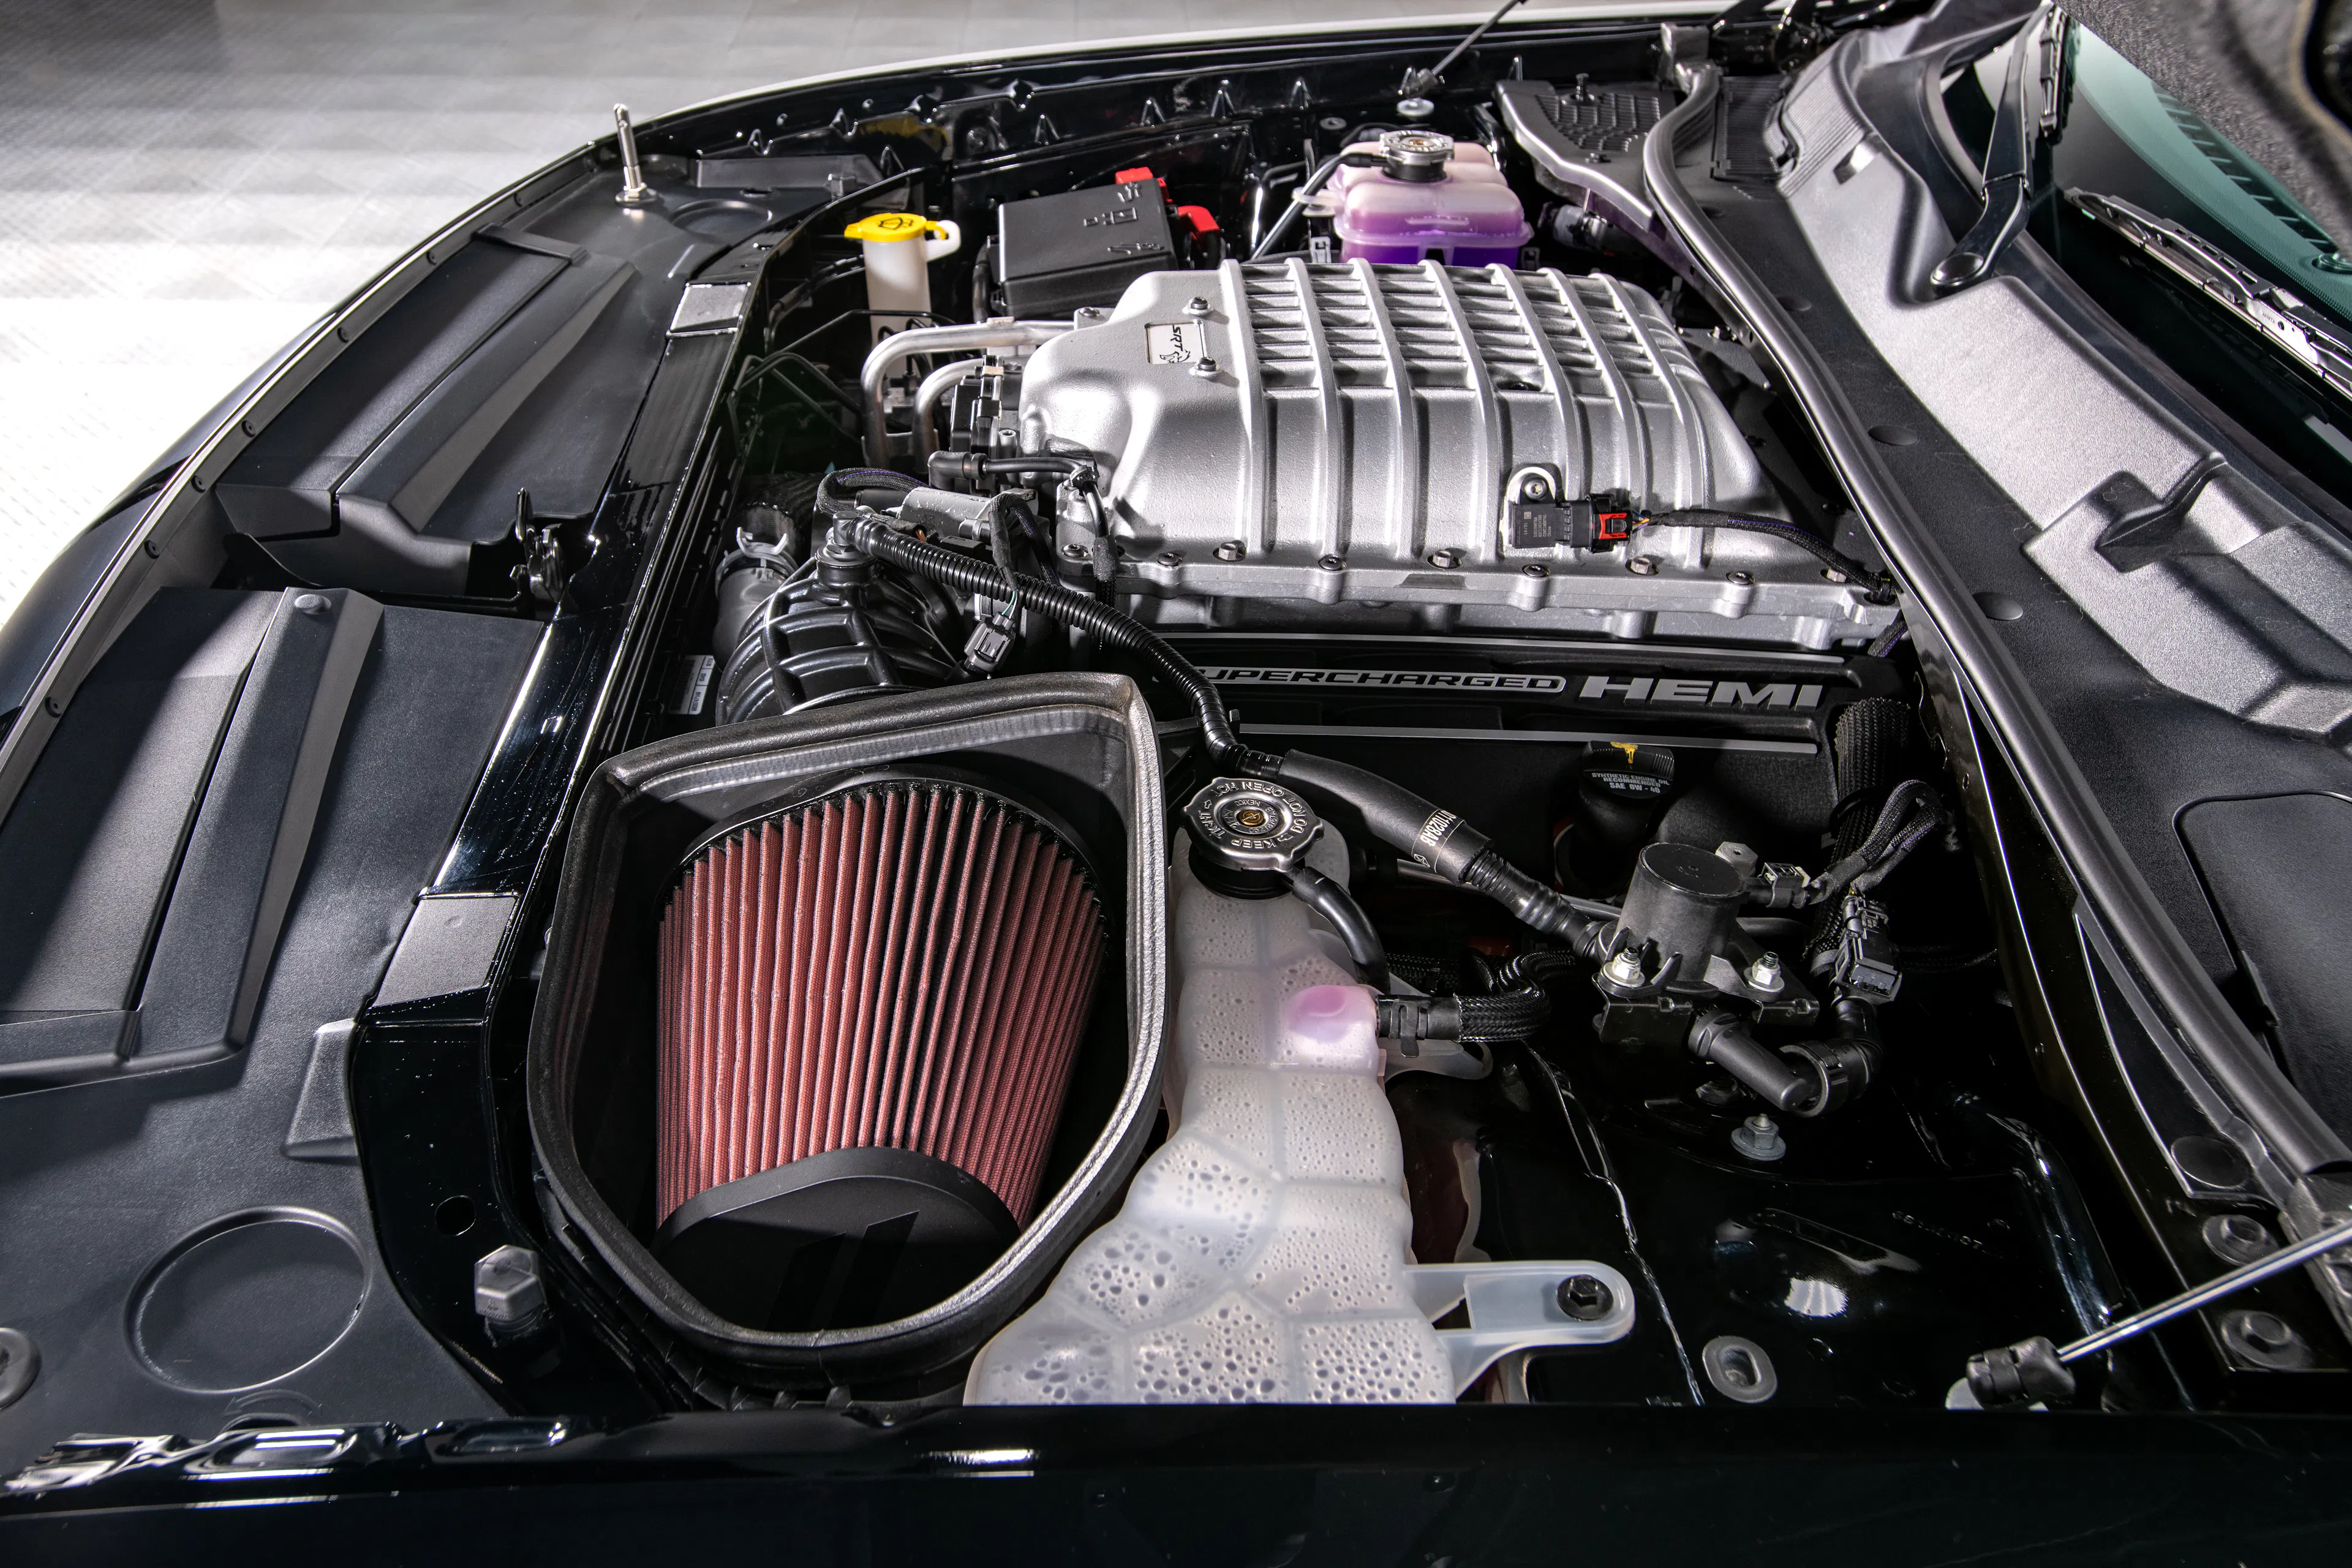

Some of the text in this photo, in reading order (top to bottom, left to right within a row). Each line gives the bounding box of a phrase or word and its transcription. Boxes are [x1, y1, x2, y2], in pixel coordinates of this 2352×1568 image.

[1170, 324, 1183, 351] SRT
[1199, 669, 1561, 689] UPERCHARGED
[1579, 676, 1823, 710] HEMI
[1603, 777, 1661, 788] RECOMMENDED
[1631, 775, 1657, 783] ENGINE
[1211, 781, 1308, 834] DO NOT OPEN HOT
[1198, 810, 1277, 849] KEEP TIGHT
